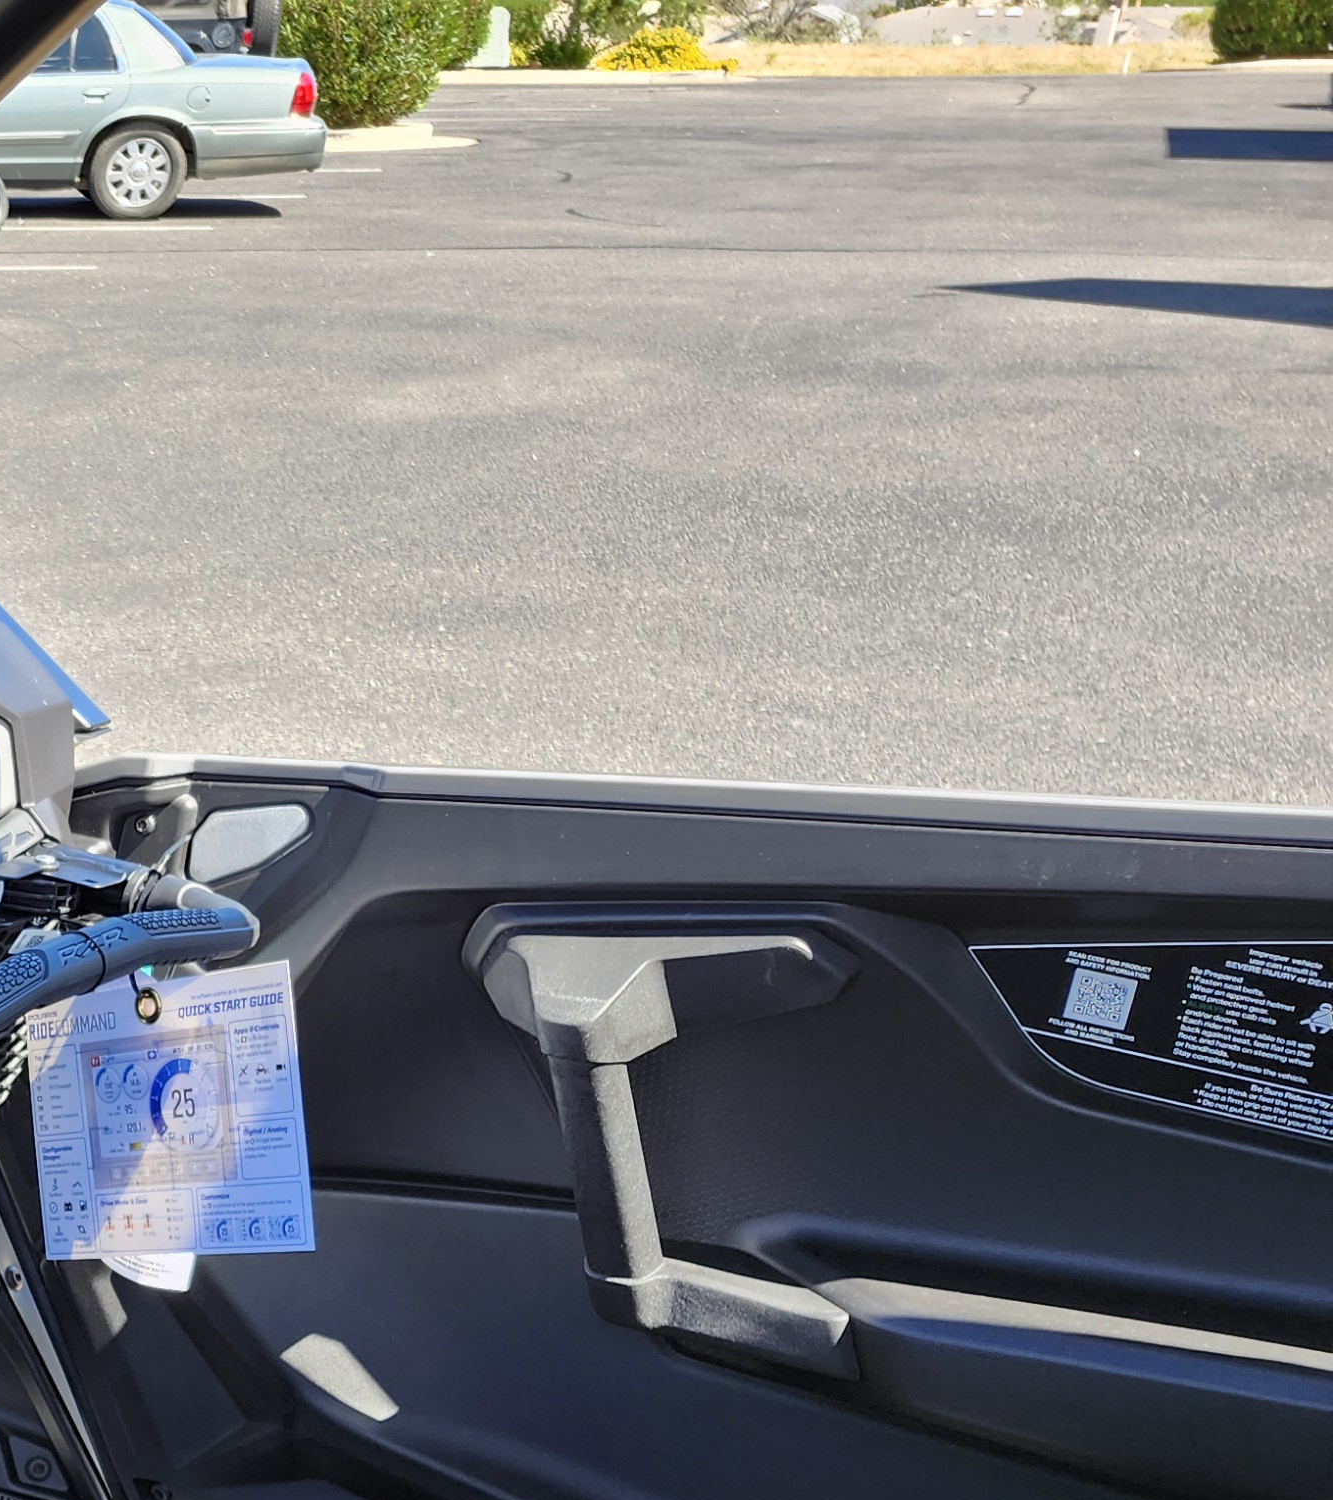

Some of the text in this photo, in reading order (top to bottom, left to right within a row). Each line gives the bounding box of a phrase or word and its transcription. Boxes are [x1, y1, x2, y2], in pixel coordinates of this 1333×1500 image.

[57, 926, 129, 967] RZR
[1249, 948, 1324, 970] Improper vehicle
[1065, 957, 1079, 965] AND
[1080, 960, 1105, 970] SAFETY
[1087, 954, 1106, 963] CODE
[1106, 958, 1120, 966] FOR
[1121, 961, 1152, 973] PRODUCT
[1191, 967, 1244, 984] Be Prepared
[1225, 961, 1262, 975] SEVERE
[1262, 968, 1297, 982] INJURY
[1308, 977, 1333, 990] DEAT
[1249, 958, 1318, 978] use can result in
[1195, 975, 1222, 987] Fasten
[1223, 982, 1242, 991] seat
[178, 992, 283, 1019] QUICK START GUIDE
[1190, 993, 1206, 1001] and
[1206, 996, 1248, 1010] protective
[1193, 983, 1214, 994] Wear
[1226, 992, 1266, 1005] approved
[1266, 1000, 1296, 1012] helmet
[1048, 1017, 1075, 1028] FOLLOW
[1075, 1024, 1088, 1032] ALL
[1185, 1009, 1212, 1019] and/or
[1241, 1012, 1257, 1021] cab
[1258, 1017, 1277, 1025] nets
[1064, 1028, 1078, 1036] AND
[1180, 1024, 1200, 1034] back
[1201, 1029, 1232, 1042] against
[1253, 1039, 1270, 1049] feet
[1270, 1042, 1284, 1053] flat
[1297, 1049, 1311, 1058] the
[1182, 1016, 1203, 1026] Each
[1204, 1021, 1223, 1030] rider
[1223, 1025, 1245, 1035] must
[1246, 1029, 1257, 1038] be
[1257, 1032, 1276, 1042] able
[1286, 1038, 1297, 1047] sit
[1297, 1042, 1316, 1051] with
[1173, 1048, 1191, 1058] Stay
[1192, 1053, 1237, 1069] completely
[1237, 1062, 1262, 1074] inside
[1263, 1068, 1277, 1077] the
[1198, 1037, 1215, 1046] and
[1215, 1039, 1241, 1052] hands
[1253, 1048, 1287, 1064] steering
[1288, 1057, 1314, 1068] wheel
[171, 1088, 196, 1118] 25
[1199, 1090, 1220, 1100] Keep
[1227, 1096, 1243, 1105] firm
[1244, 1100, 1261, 1110] grip
[1261, 1104, 1272, 1112] on
[1273, 1106, 1287, 1115] the
[1288, 1110, 1321, 1125] steering
[1211, 1084, 1227, 1094] you
[1227, 1087, 1248, 1098] think
[1258, 1094, 1274, 1104] feel
[1274, 1098, 1288, 1107] the
[1289, 1102, 1318, 1114] vehicle
[1250, 1084, 1330, 1109] Be Sure Riders Pay
[1202, 1098, 1214, 1107] Do
[1214, 1102, 1229, 1112] not
[1229, 1104, 1243, 1115] put
[1244, 1108, 1260, 1119] any
[1259, 1111, 1278, 1123] part
[1278, 1116, 1287, 1124] of
[1286, 1119, 1306, 1129] your
[1307, 1122, 1329, 1135] body
[267, 1126, 288, 1135] Analog
